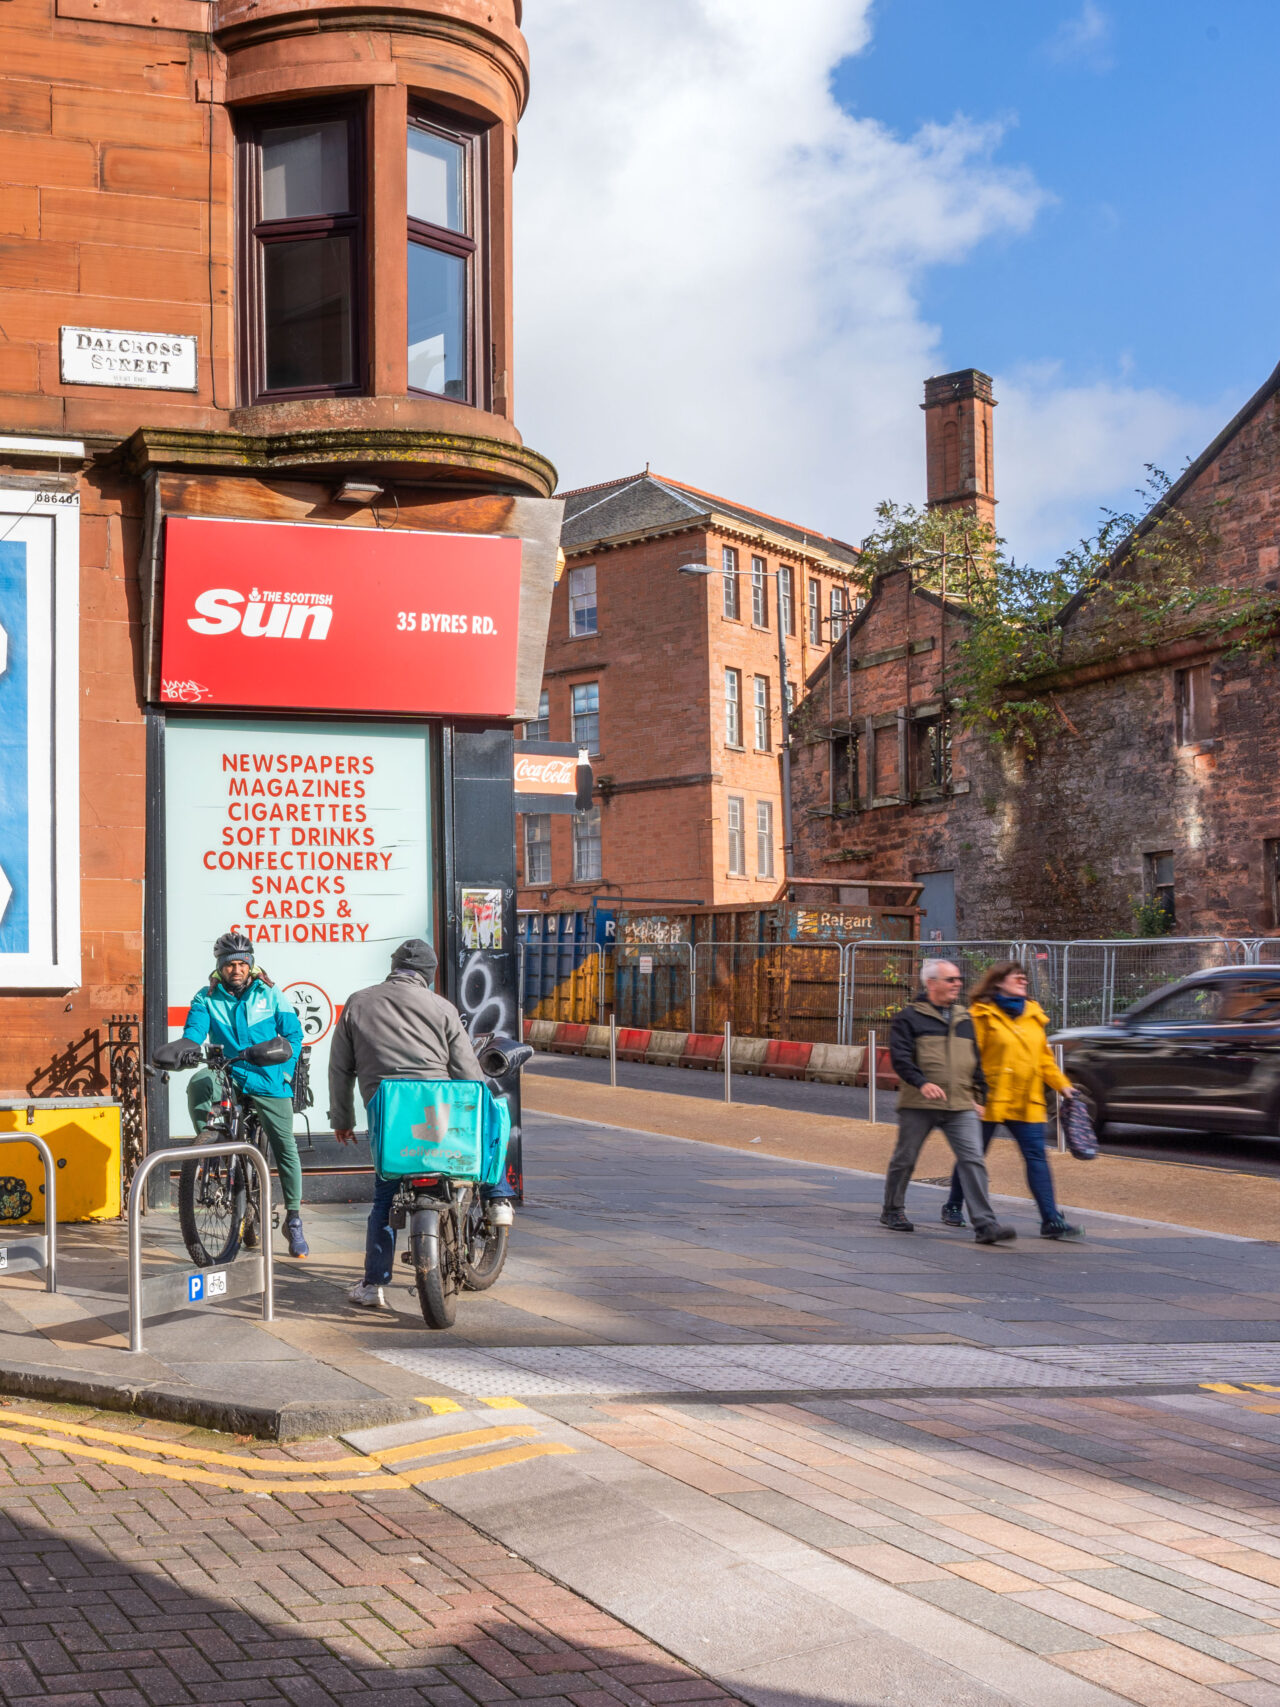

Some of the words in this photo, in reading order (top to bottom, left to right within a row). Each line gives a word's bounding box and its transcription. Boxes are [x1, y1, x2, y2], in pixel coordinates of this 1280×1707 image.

[75, 333, 183, 357] DALCROSS
[91, 354, 172, 375] STREET
[36, 493, 80, 504] 086401
[262, 591, 281, 603] THE
[283, 592, 333, 605] SCOTTISH
[186, 588, 334, 640] Sun
[396, 611, 417, 631] 35
[421, 613, 468, 633] BYRES
[472, 615, 498, 635] RD.
[222, 754, 375, 775] NEWSPAPERS
[228, 778, 366, 798] MAGAZINES
[228, 802, 367, 822] CIGARETTES
[222, 827, 280, 847] SOFT
[292, 827, 375, 846] DRINKS
[203, 851, 393, 871] CONFECTIONERY
[252, 875, 345, 895] SNACKS
[245, 899, 325, 919] CARDS
[336, 899, 352, 918] &
[821, 913, 873, 929] Reigart
[294, 991, 312, 1004] No
[400, 1146, 462, 1159] deliveroo
[191, 1277, 201, 1298] P
